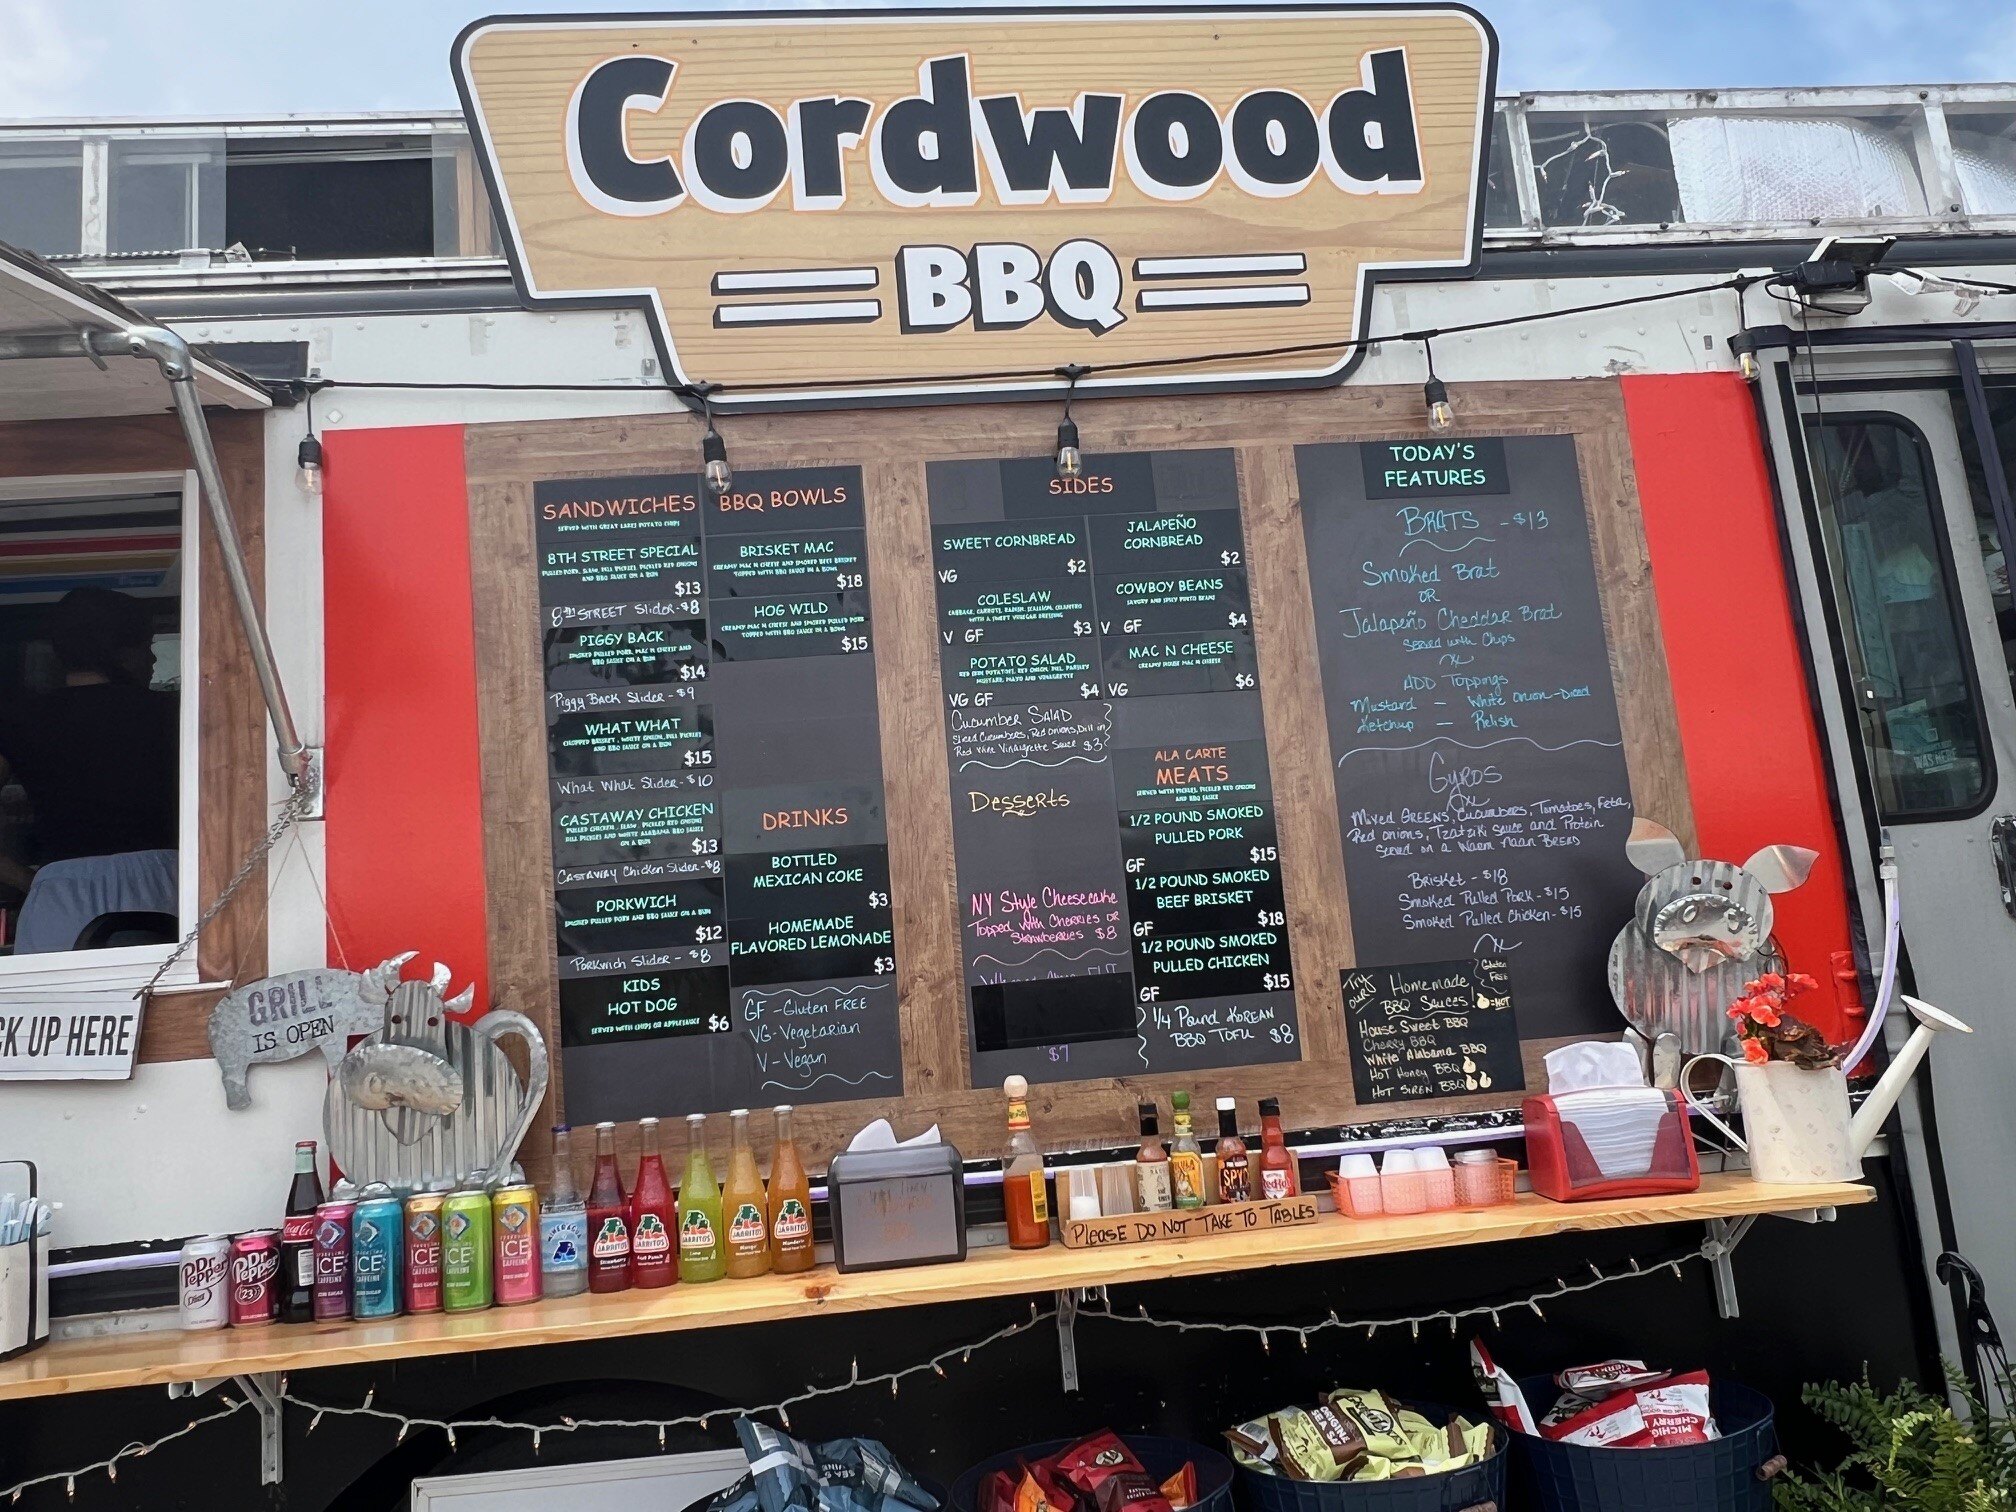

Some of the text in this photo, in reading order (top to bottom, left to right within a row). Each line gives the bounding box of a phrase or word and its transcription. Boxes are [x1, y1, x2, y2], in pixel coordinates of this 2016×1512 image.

[566, 45, 1429, 217] Cordwood
[896, 238, 1128, 335] BBQ
[1389, 443, 1474, 461] TODAY'S
[1050, 477, 1113, 494] SIDES
[1385, 469, 1485, 487] FEATURES
[543, 495, 695, 519] SANDWICHES
[720, 488, 846, 512] BBQ BOWLS
[1127, 514, 1196, 533] JALAPEÑO
[740, 541, 833, 557] BRISKET MAC
[944, 533, 1075, 550] SWEET CORNBREAD
[1125, 534, 1202, 549] CORNBREAD
[548, 544, 698, 564] 8TH STREET SPECIAL
[1221, 550, 1240, 566] $2
[939, 559, 1086, 583] VG $2
[1452, 558, 1499, 580] Brat
[675, 581, 701, 597] $13
[837, 573, 862, 590] $18
[1116, 579, 1223, 594] COWBOY BEANS
[978, 591, 1050, 605] COLESLAW
[1419, 588, 1440, 602] OR
[755, 602, 828, 617] HOG WILD
[943, 620, 1091, 644] V GF $3
[1101, 612, 1247, 634] V GF $4
[580, 631, 664, 646] PIGGY BACK
[842, 636, 867, 652] $15
[1130, 641, 1233, 659] MAC N CHEESE
[970, 653, 1076, 670] POTATO SALAD
[681, 664, 705, 681] $14
[1108, 673, 1254, 696] VG $6
[949, 683, 1099, 707] VG GF $4
[585, 718, 681, 735] WHAT WHAT
[685, 750, 711, 767] $15
[1155, 747, 1226, 761] ALA CARTE
[1157, 766, 1228, 785] MEATS
[559, 803, 713, 828] CASTAWAY CHICKEN
[763, 808, 847, 830] DRINKS
[1130, 806, 1263, 826] 1/2 POUND SMOKED
[1156, 827, 1243, 844] PULLED PORK
[692, 838, 717, 855] $13
[772, 853, 837, 868] BOTTLED
[1126, 846, 1276, 872] GF $15
[754, 869, 863, 887] MEXICAN COKE
[1136, 870, 1269, 890] 1/2 POUND SMOKED
[597, 895, 676, 912] PORKWICH
[869, 891, 888, 909] $3
[973, 893, 991, 916] NY
[1157, 890, 1253, 909] BEEF BRISKET
[769, 916, 853, 934] HOMEMADE
[1133, 910, 1284, 936] GF $18
[696, 926, 722, 943] $12
[732, 931, 891, 955] FLAVORED LEMONADE
[1142, 933, 1277, 953] 1/2 POUND SMOKED
[874, 957, 894, 974] $3
[1154, 954, 1269, 973] PULLED CHICKEN
[624, 978, 660, 993] KIDS
[1140, 973, 1290, 1001] GF $15
[1390, 973, 1469, 996] Homemade
[248, 976, 334, 1026] GRILL
[609, 998, 677, 1015] HOT DOG
[1380, 998, 1411, 1015] BBQ
[709, 1014, 729, 1032] $6
[1359, 1017, 1468, 1038] House Sweet BBQ
[28, 1016, 62, 1057] UP
[66, 1015, 134, 1056] HERE
[253, 1015, 335, 1054] IS OPEN
[1459, 1043, 1486, 1054] BBQ
[1438, 1078, 1465, 1093] BBQ
[1135, 1222, 1156, 1239] DO
[1162, 1219, 1192, 1235] NOT
[1196, 1213, 1233, 1231] TAKE
[1235, 1208, 1258, 1226] TO
[1258, 1203, 1315, 1224] TABLES
[411, 1246, 440, 1265] ICE
[445, 1246, 472, 1264] ICE
[501, 1238, 530, 1256] ICE
[196, 1257, 215, 1272] Dr
[248, 1251, 268, 1267] Dr
[316, 1255, 345, 1275] ICE
[355, 1255, 383, 1273] ICE
[182, 1260, 228, 1288] Pepper
[233, 1255, 278, 1283] Pepper
[242, 1289, 254, 1299] 23
[1311, 1409, 1328, 1430] SEA
[1653, 1416, 1699, 1427] CHERRY
